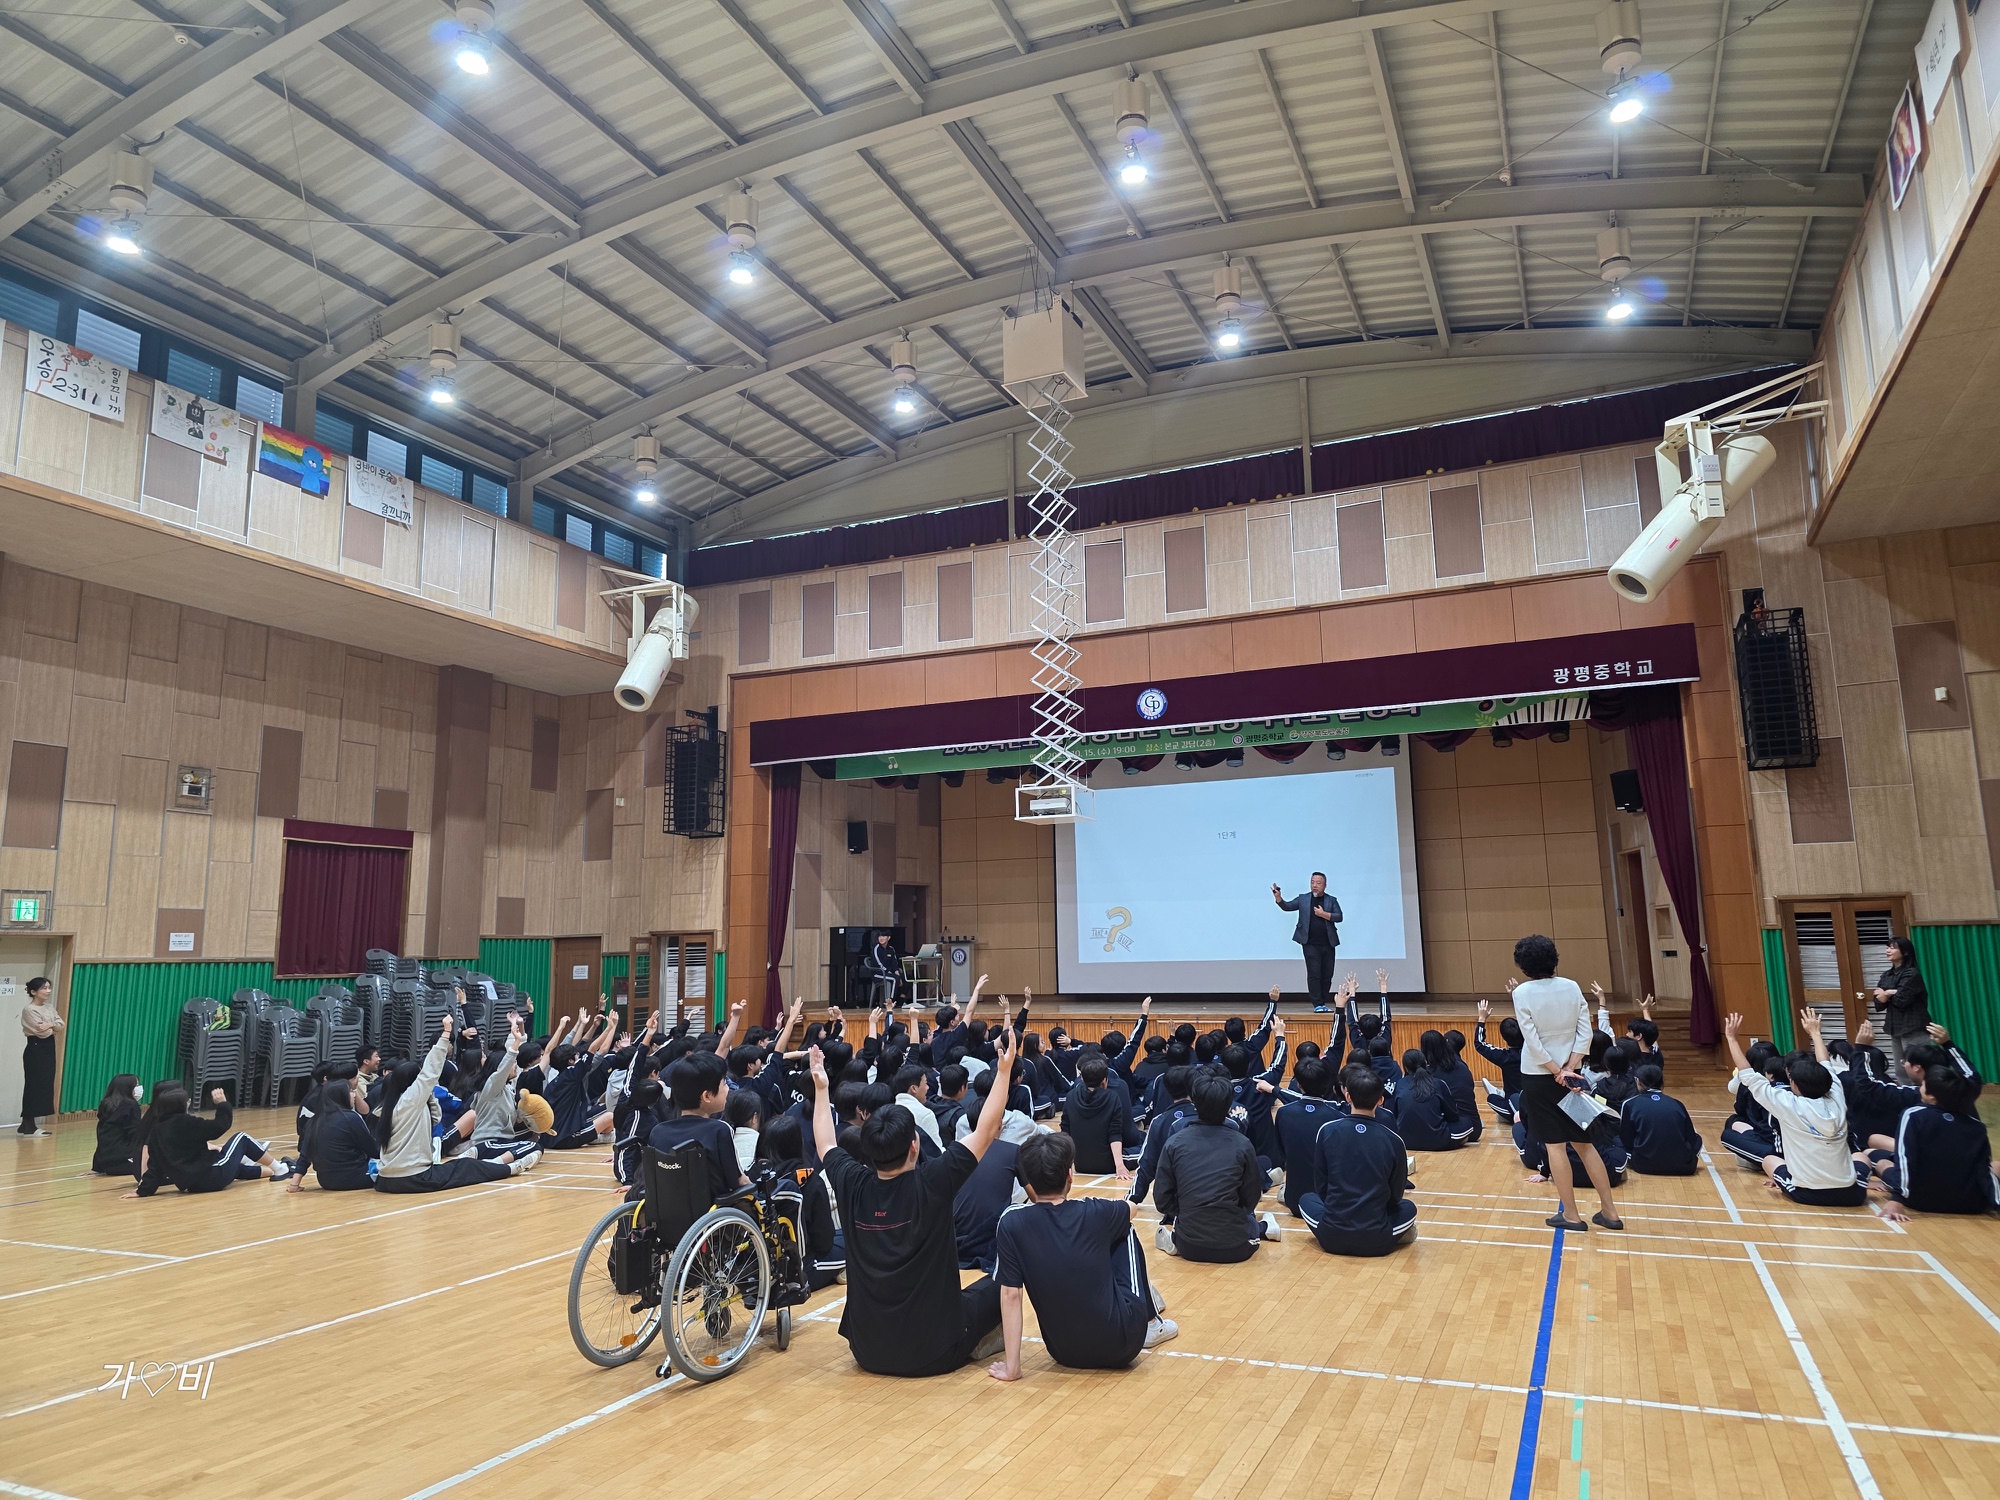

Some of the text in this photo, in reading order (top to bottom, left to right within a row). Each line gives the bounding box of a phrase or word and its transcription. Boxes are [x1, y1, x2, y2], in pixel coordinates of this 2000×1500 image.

[37, 338, 54, 378] 우승
[1553, 659, 1654, 684] 광평중학교
[1084, 749, 1095, 757] 15.
[1097, 747, 1111, 756] (수)
[1112, 745, 1136, 755] 19:00
[1217, 831, 1236, 839] 1단계
[790, 1089, 805, 1103] KO
